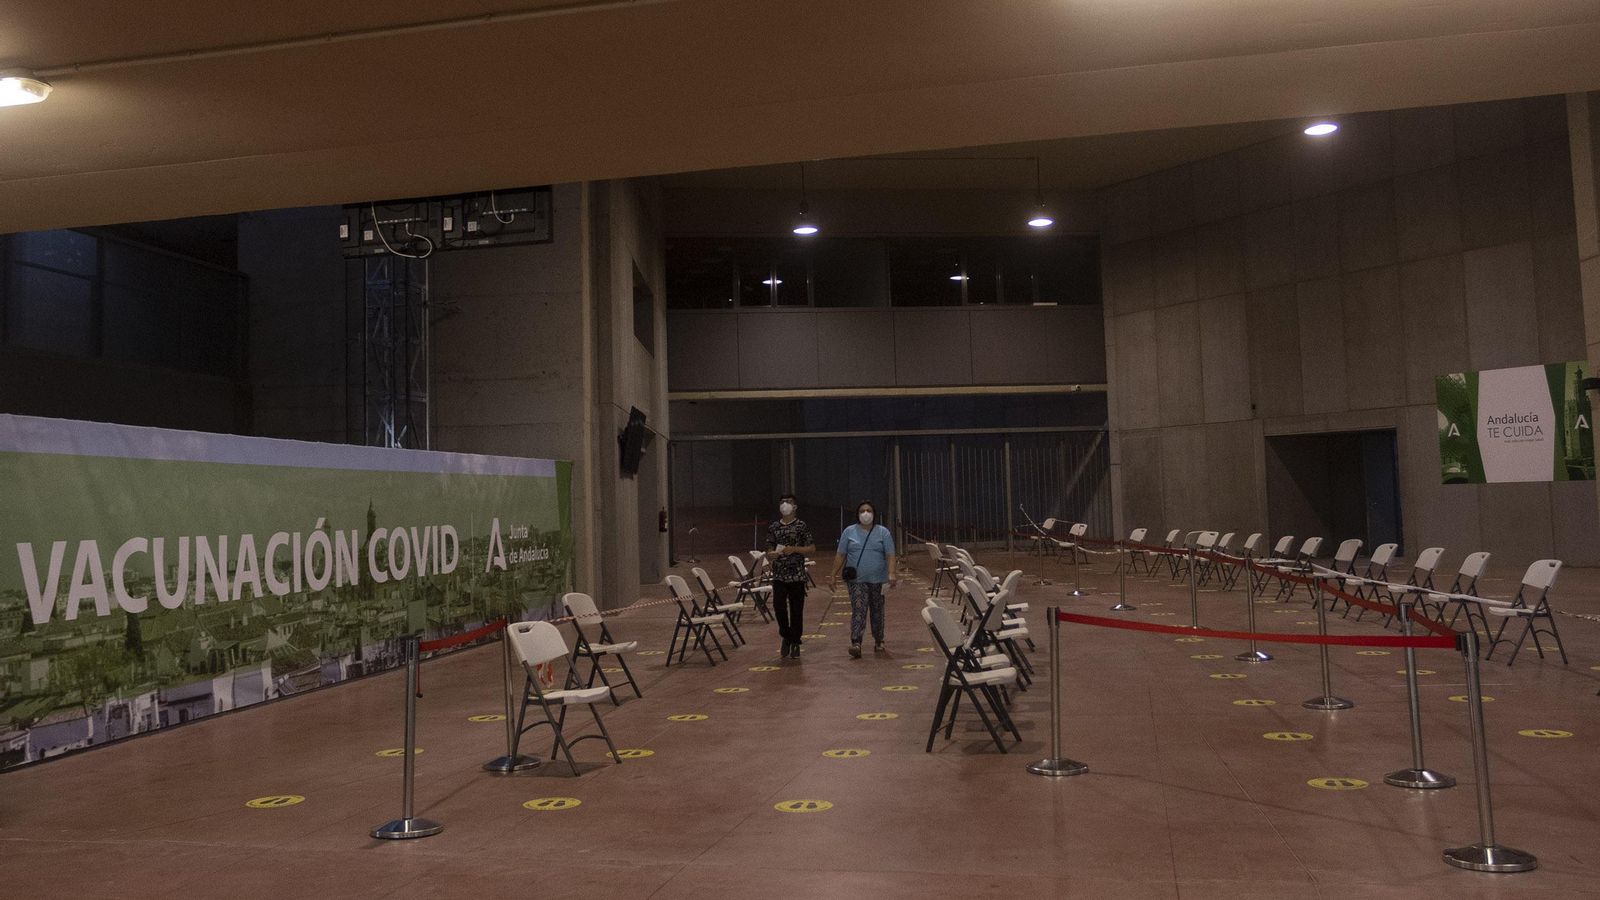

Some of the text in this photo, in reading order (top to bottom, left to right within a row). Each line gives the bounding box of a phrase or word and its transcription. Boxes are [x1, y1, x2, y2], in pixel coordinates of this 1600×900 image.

[1487, 412, 1539, 425] Andalucía
[1487, 425, 1543, 438] TE CUIDA
[509, 524, 528, 539] Junta
[509, 543, 549, 564] de Andalucía
[16, 517, 460, 625] VACUNACIÓN COVID
